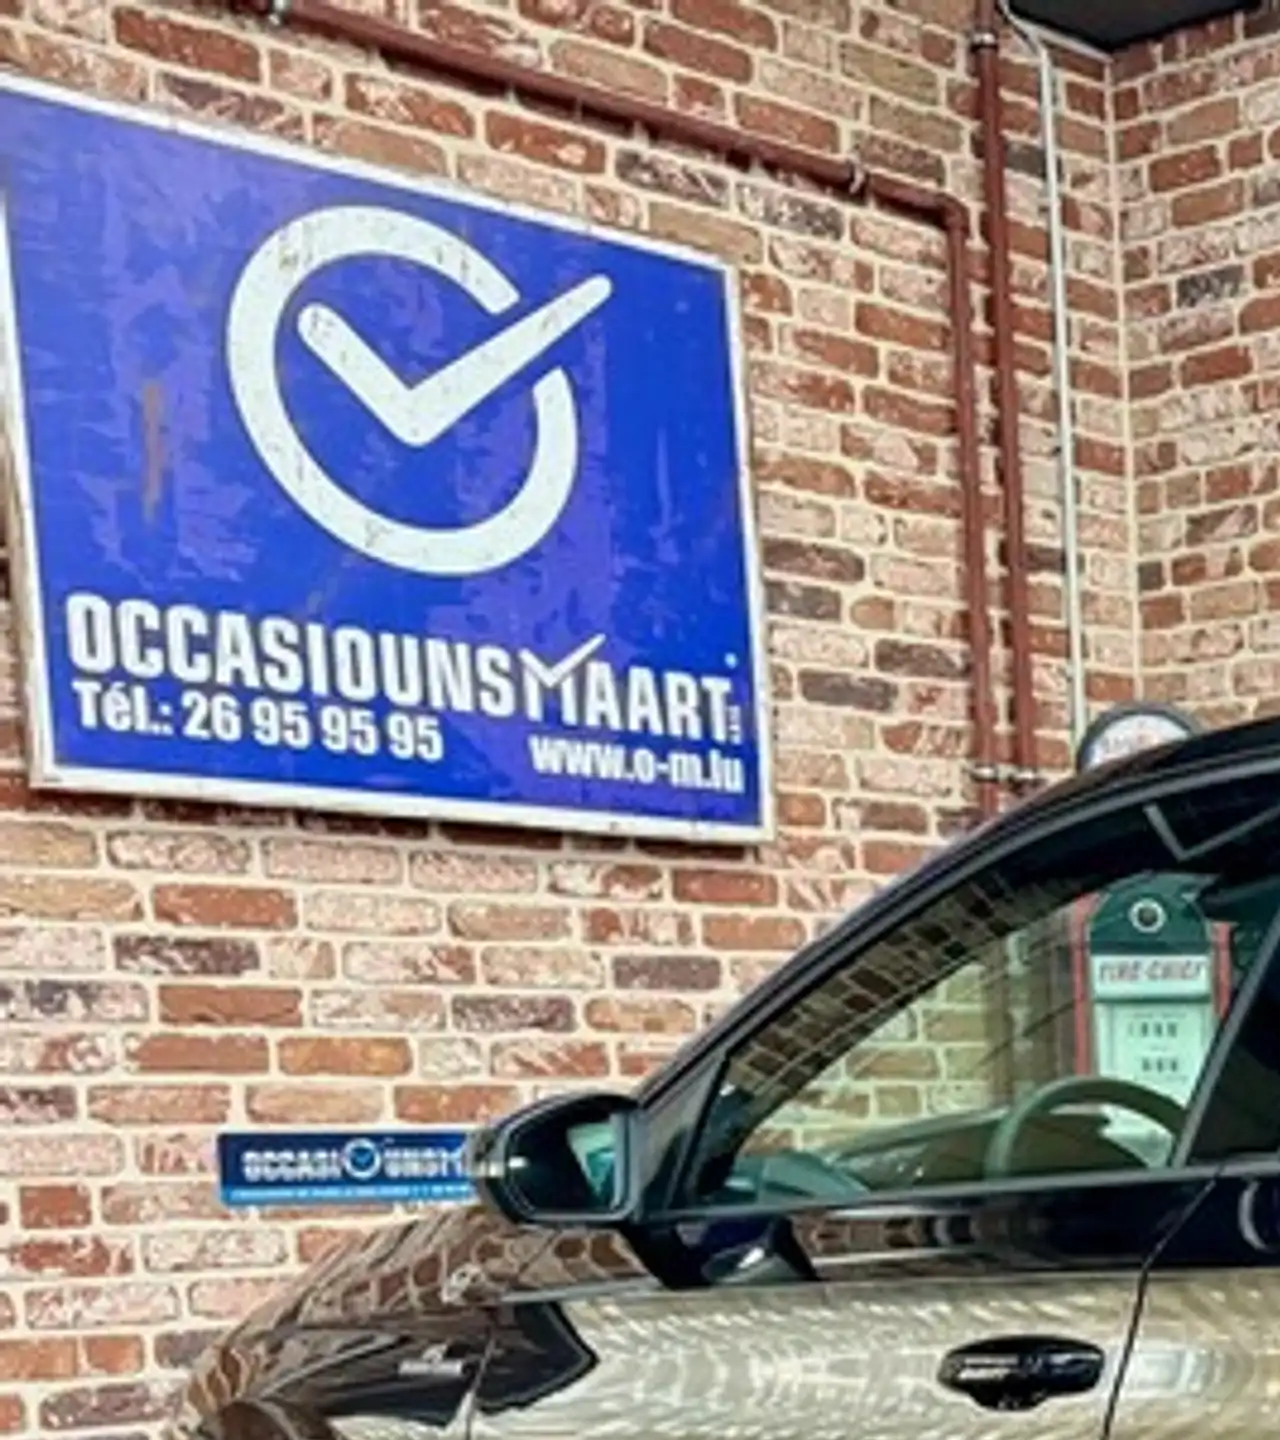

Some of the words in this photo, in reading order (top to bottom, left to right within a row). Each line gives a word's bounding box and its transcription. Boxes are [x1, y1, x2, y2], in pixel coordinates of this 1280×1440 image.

[65, 594, 732, 745] OCCASIOUNSMAART
[181, 688, 241, 742] 26
[253, 699, 309, 749] 95
[321, 706, 378, 756] 95
[388, 713, 445, 762] 95
[529, 736, 745, 794] www.o-m.lu
